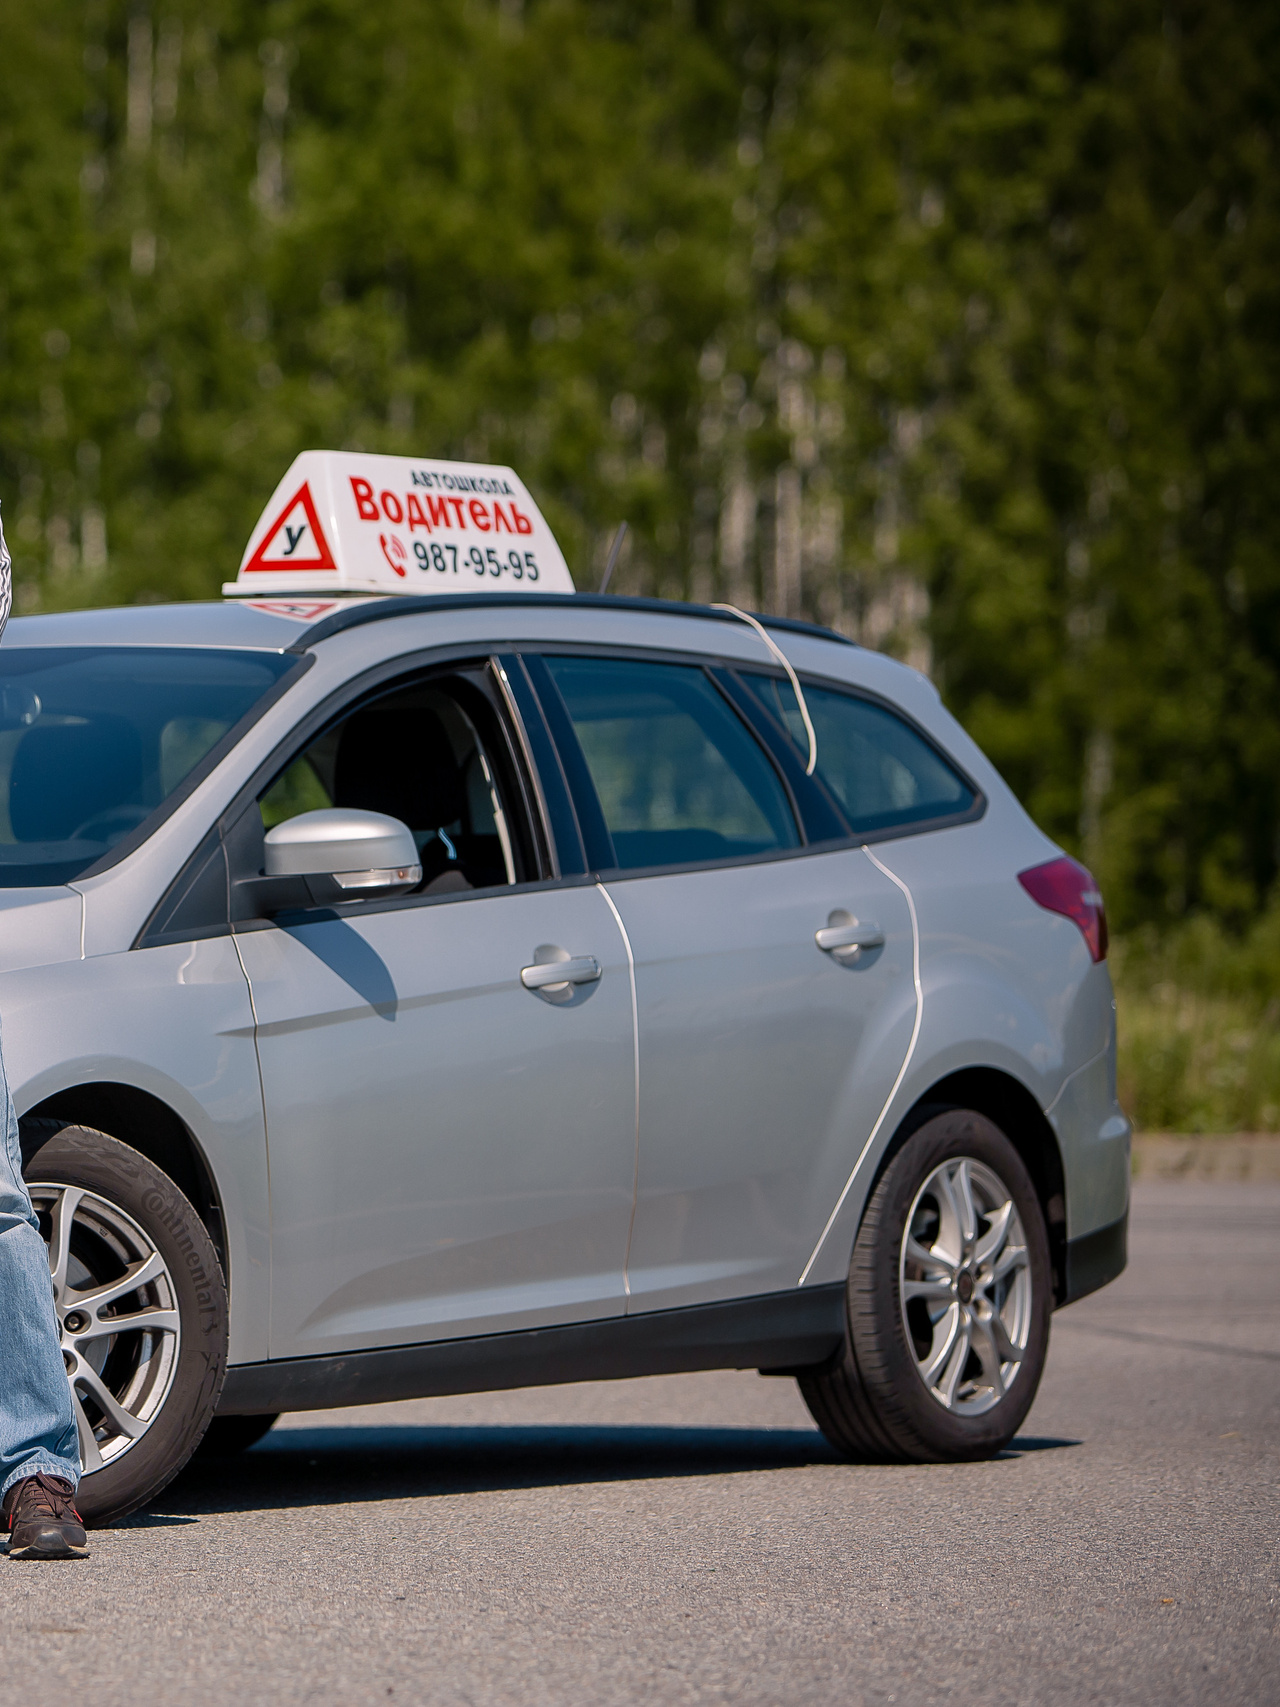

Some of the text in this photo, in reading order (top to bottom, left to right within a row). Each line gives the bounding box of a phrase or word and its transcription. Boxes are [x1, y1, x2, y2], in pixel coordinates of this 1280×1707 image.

[349, 476, 533, 536] Водитель
[411, 469, 515, 496] АВТОШКОЛА
[413, 541, 539, 582] 987-95-95
[141, 1188, 217, 1315] Continental
